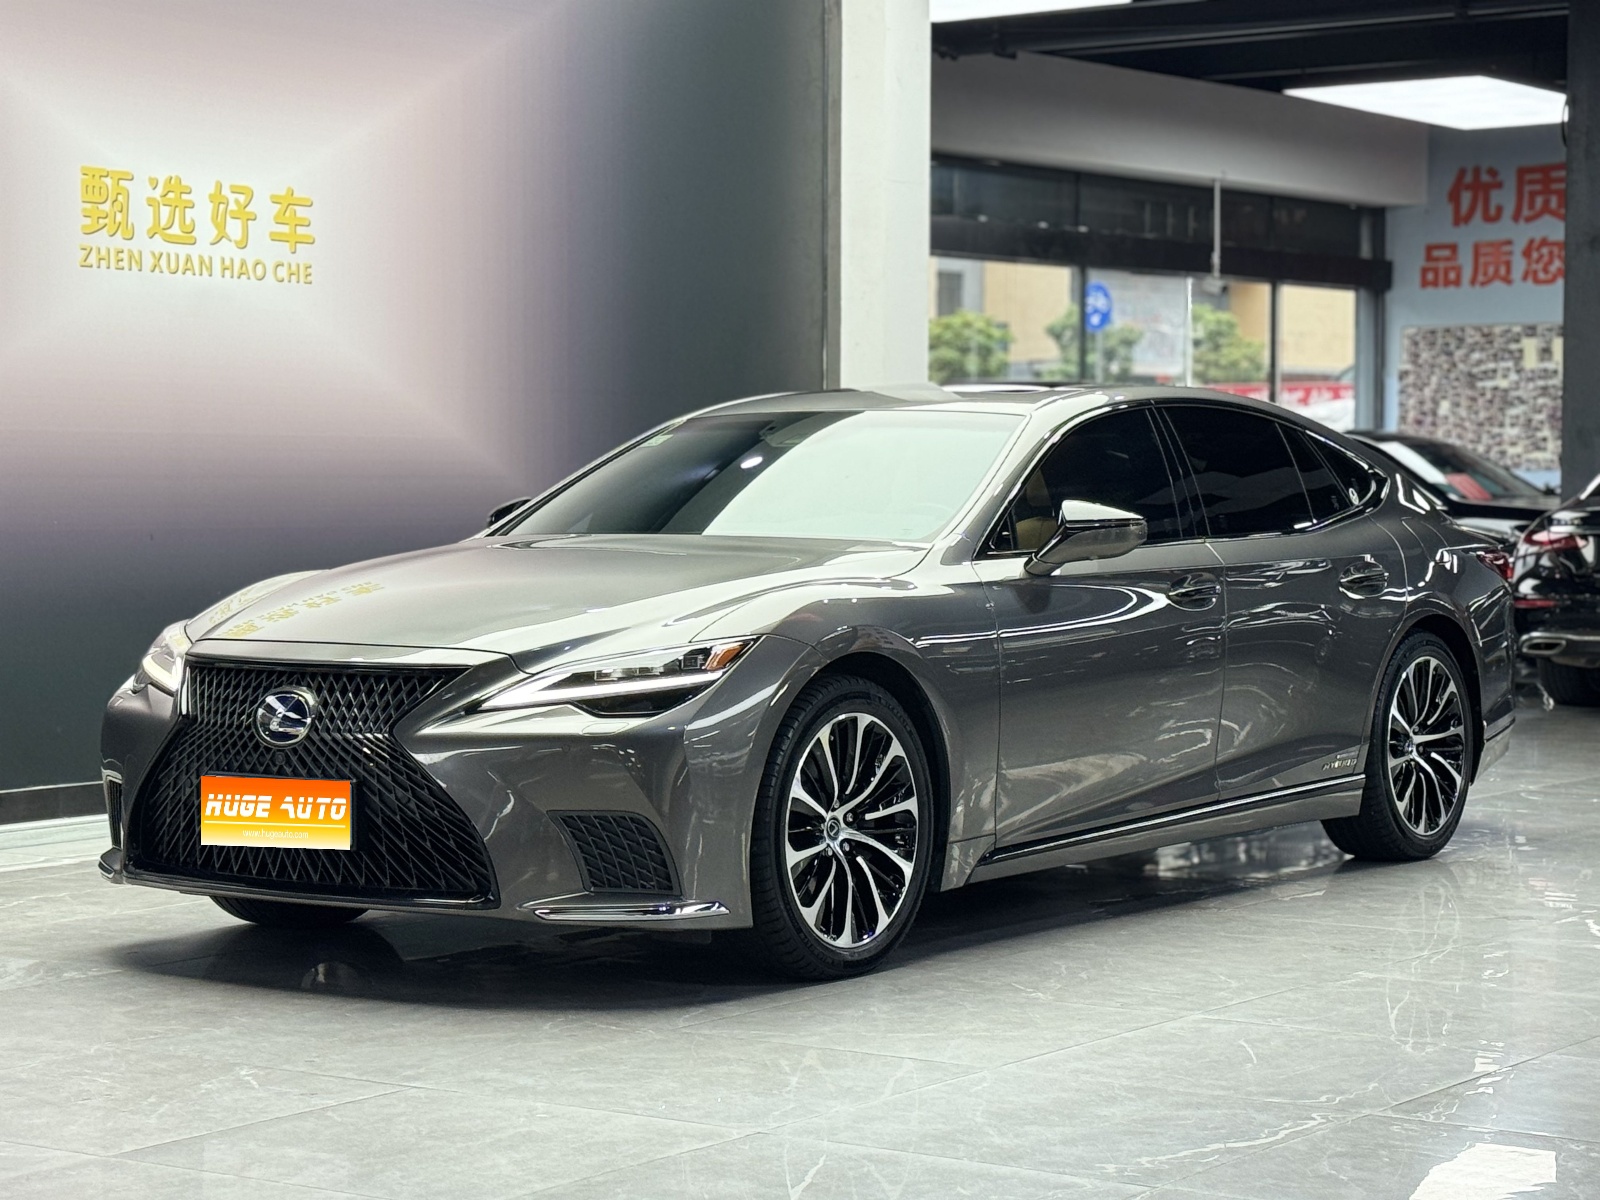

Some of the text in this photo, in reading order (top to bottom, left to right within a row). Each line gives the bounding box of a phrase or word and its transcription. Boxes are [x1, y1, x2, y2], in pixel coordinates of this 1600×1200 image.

[80, 166, 315, 253] 甄选好车
[1447, 162, 1566, 227] 优质
[79, 244, 313, 285] ZHEN XUAN HAO CHE
[1419, 236, 1565, 289] 品质您
